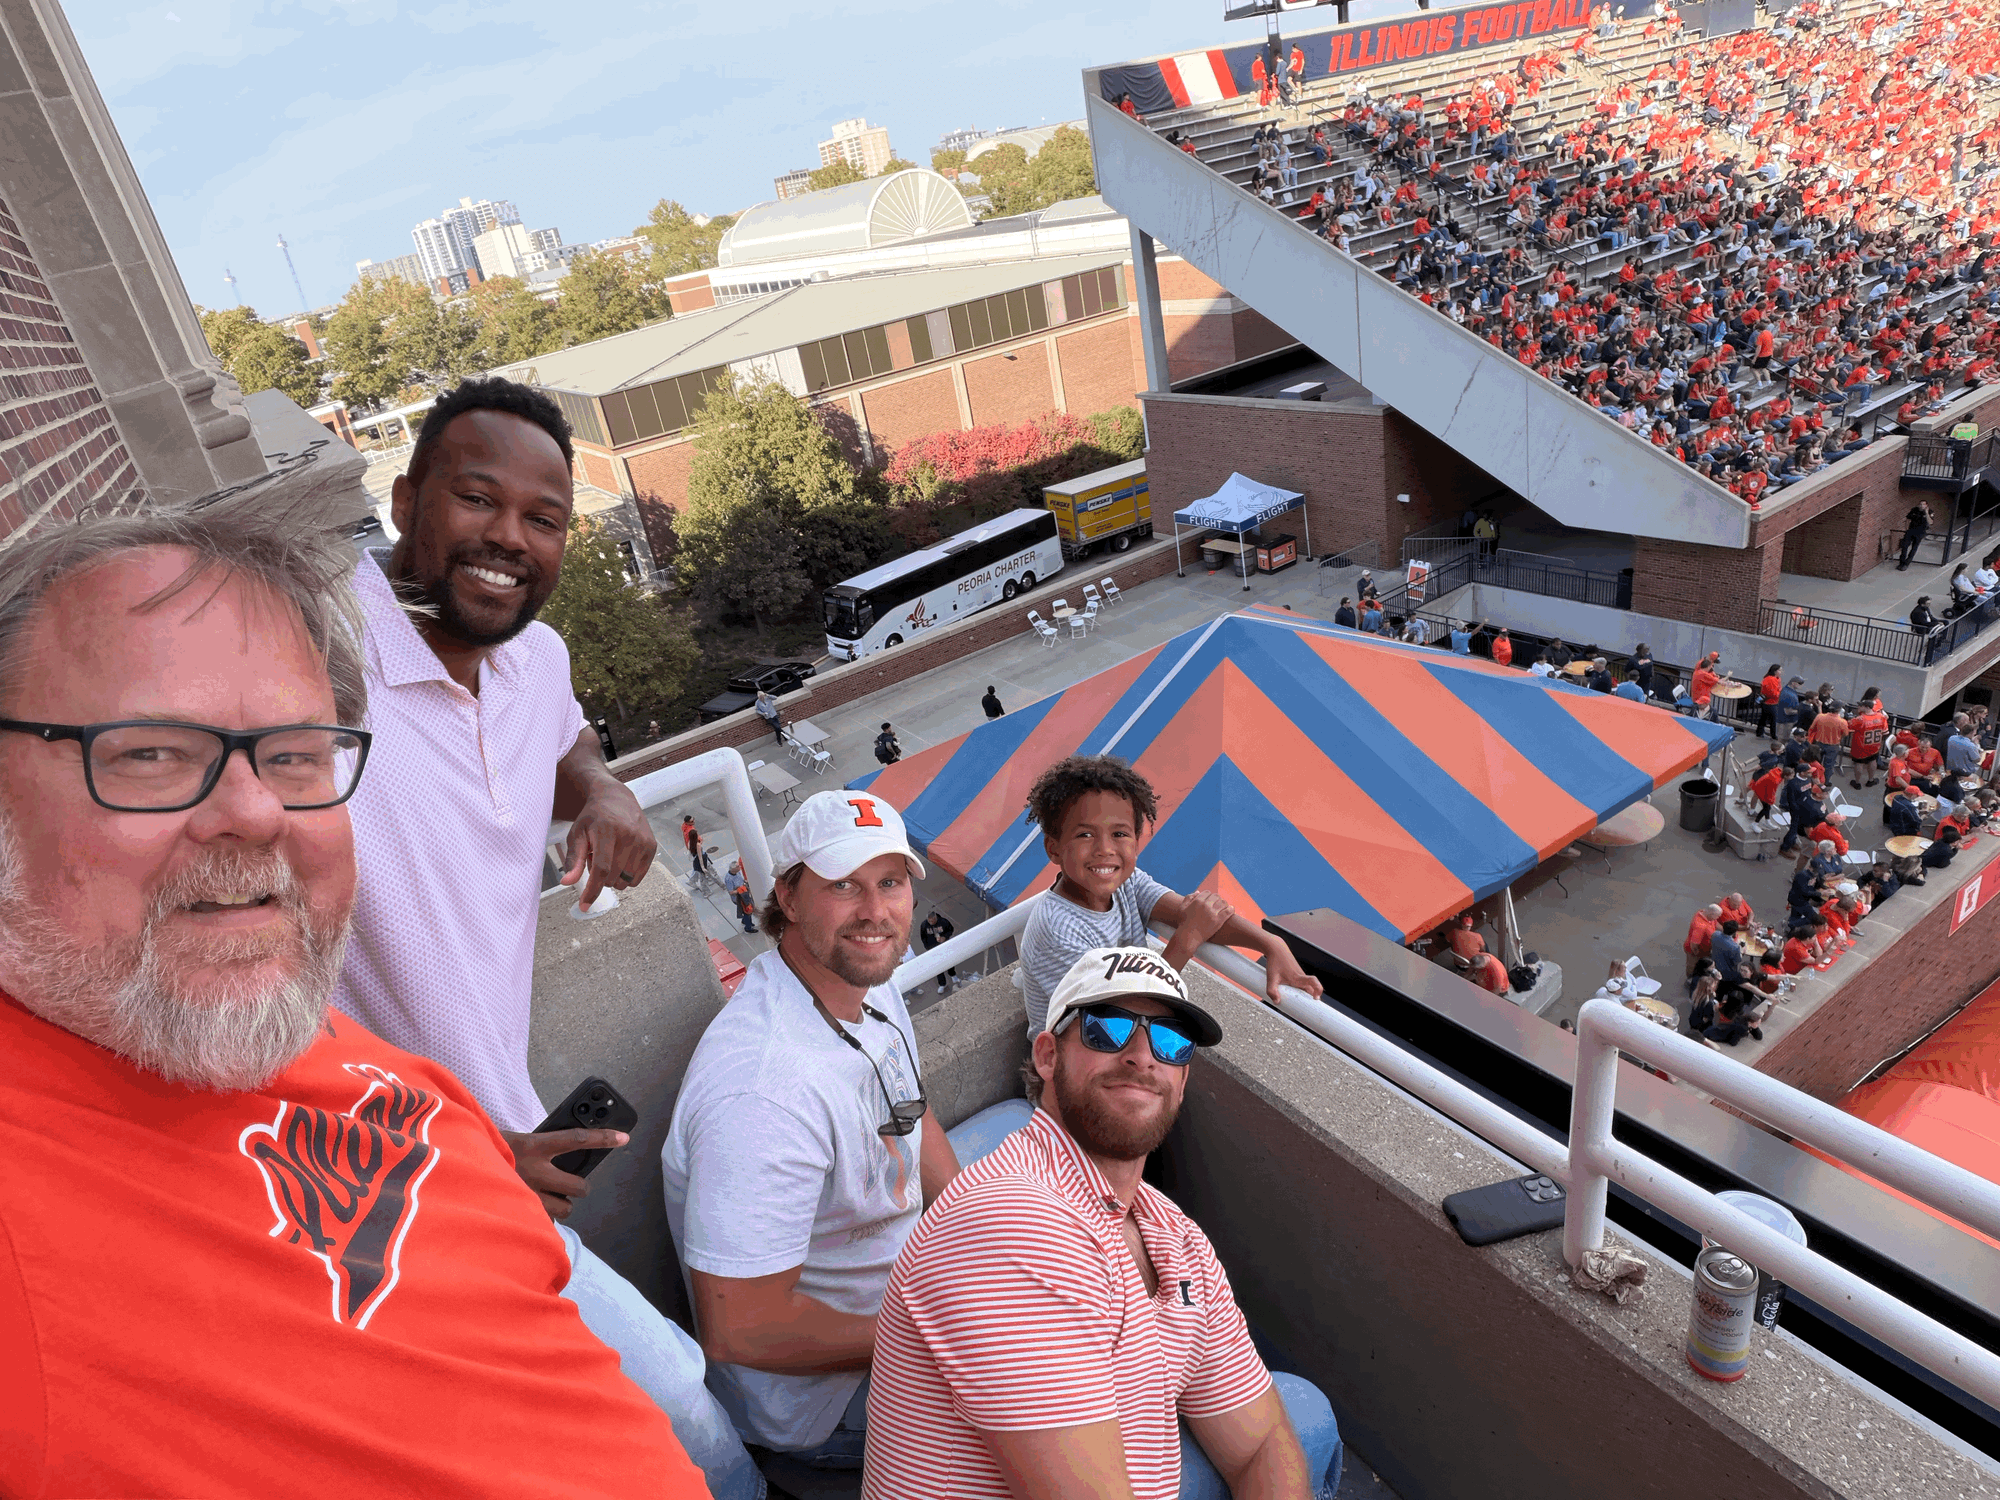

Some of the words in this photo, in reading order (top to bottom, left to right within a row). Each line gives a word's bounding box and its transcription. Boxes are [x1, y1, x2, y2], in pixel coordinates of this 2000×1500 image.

[1328, 15, 1456, 73] ILLINOIS
[1460, 0, 1591, 48] FOOTBALL
[1088, 497, 1112, 508] PENSKE
[1256, 501, 1289, 523] FLIGHT
[1189, 515, 1222, 529] FLIGHT
[957, 571, 992, 596] PEORIA
[994, 550, 1036, 578] CHARTER
[1864, 729, 1881, 745] 26
[848, 799, 884, 827] I
[1179, 1280, 1196, 1307] I
